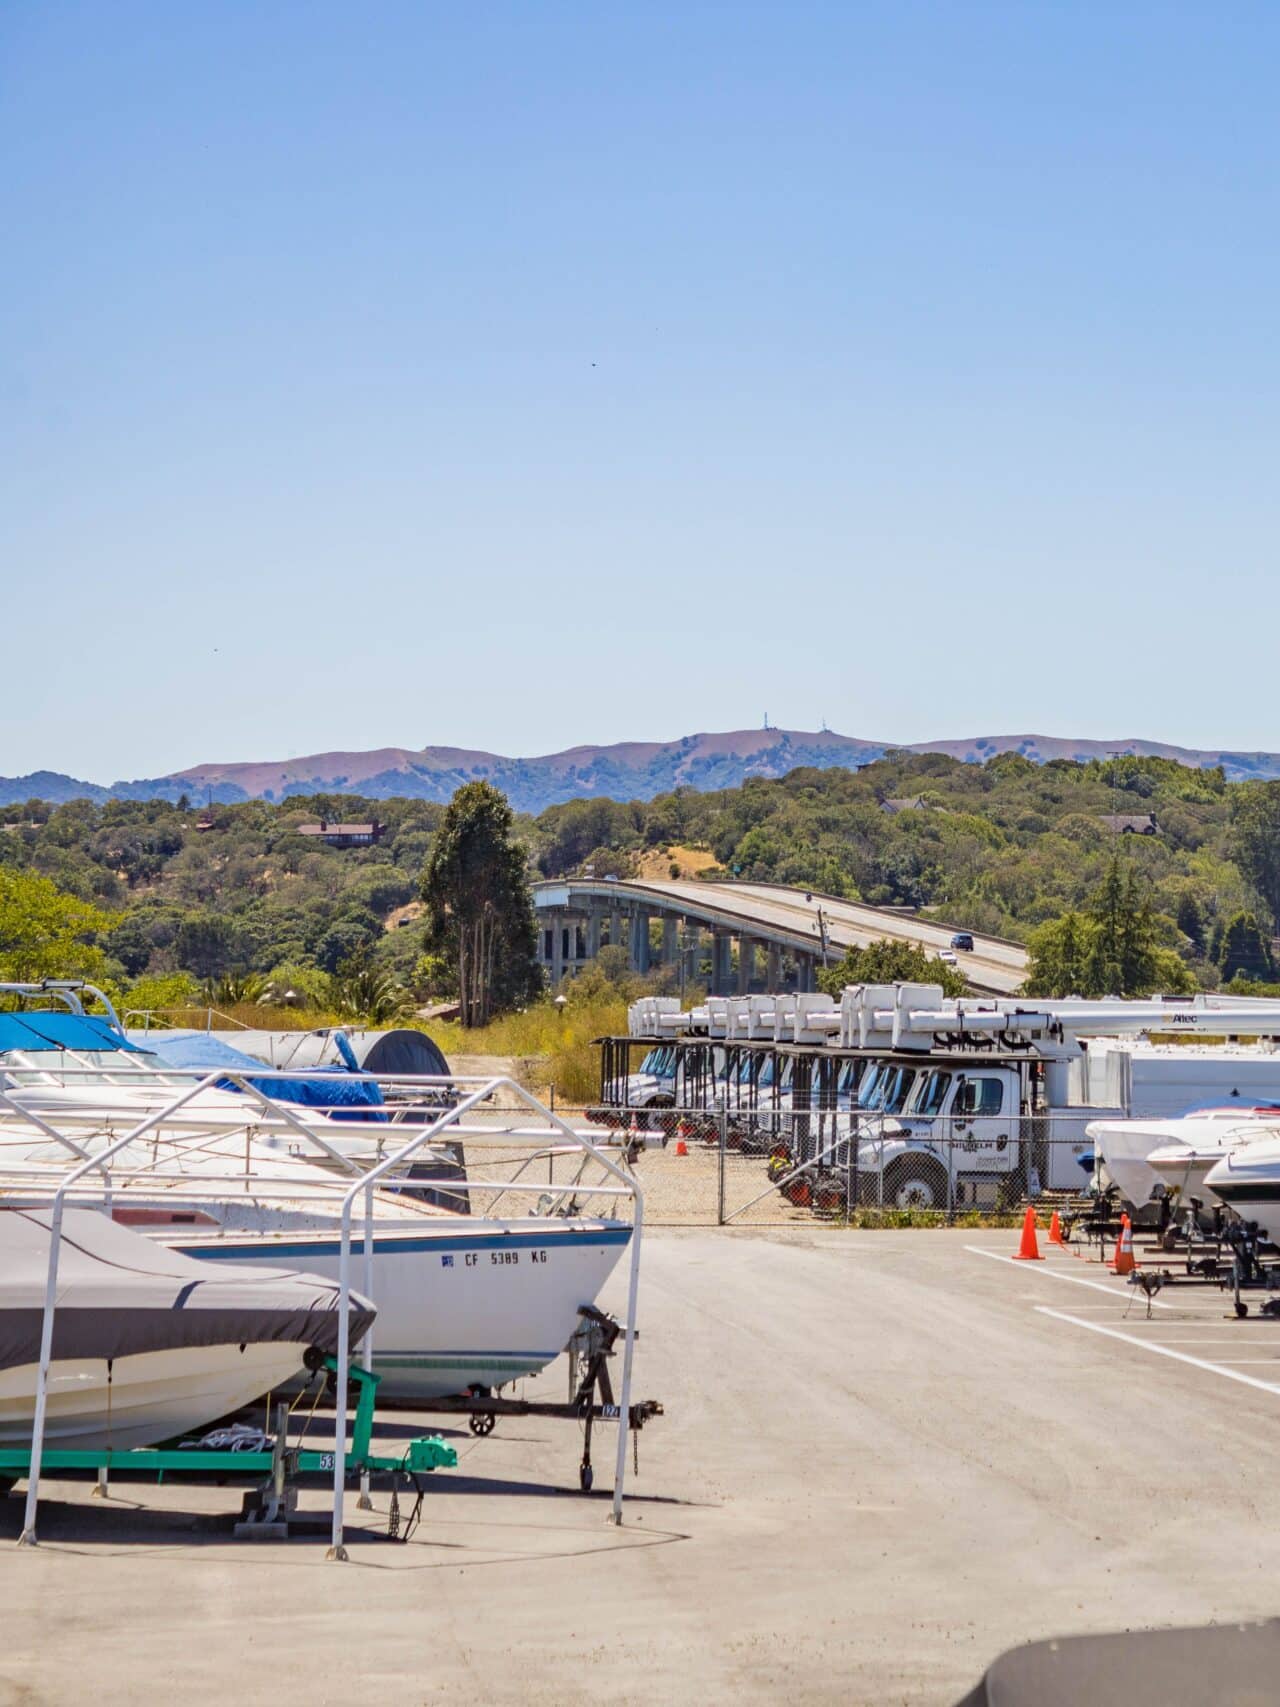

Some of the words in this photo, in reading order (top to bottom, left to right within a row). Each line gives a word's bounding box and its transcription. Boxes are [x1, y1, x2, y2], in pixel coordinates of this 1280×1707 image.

[465, 1253, 478, 1266] CF
[491, 1251, 519, 1265] 5389
[531, 1250, 547, 1263] KG
[321, 1455, 334, 1469] 53
